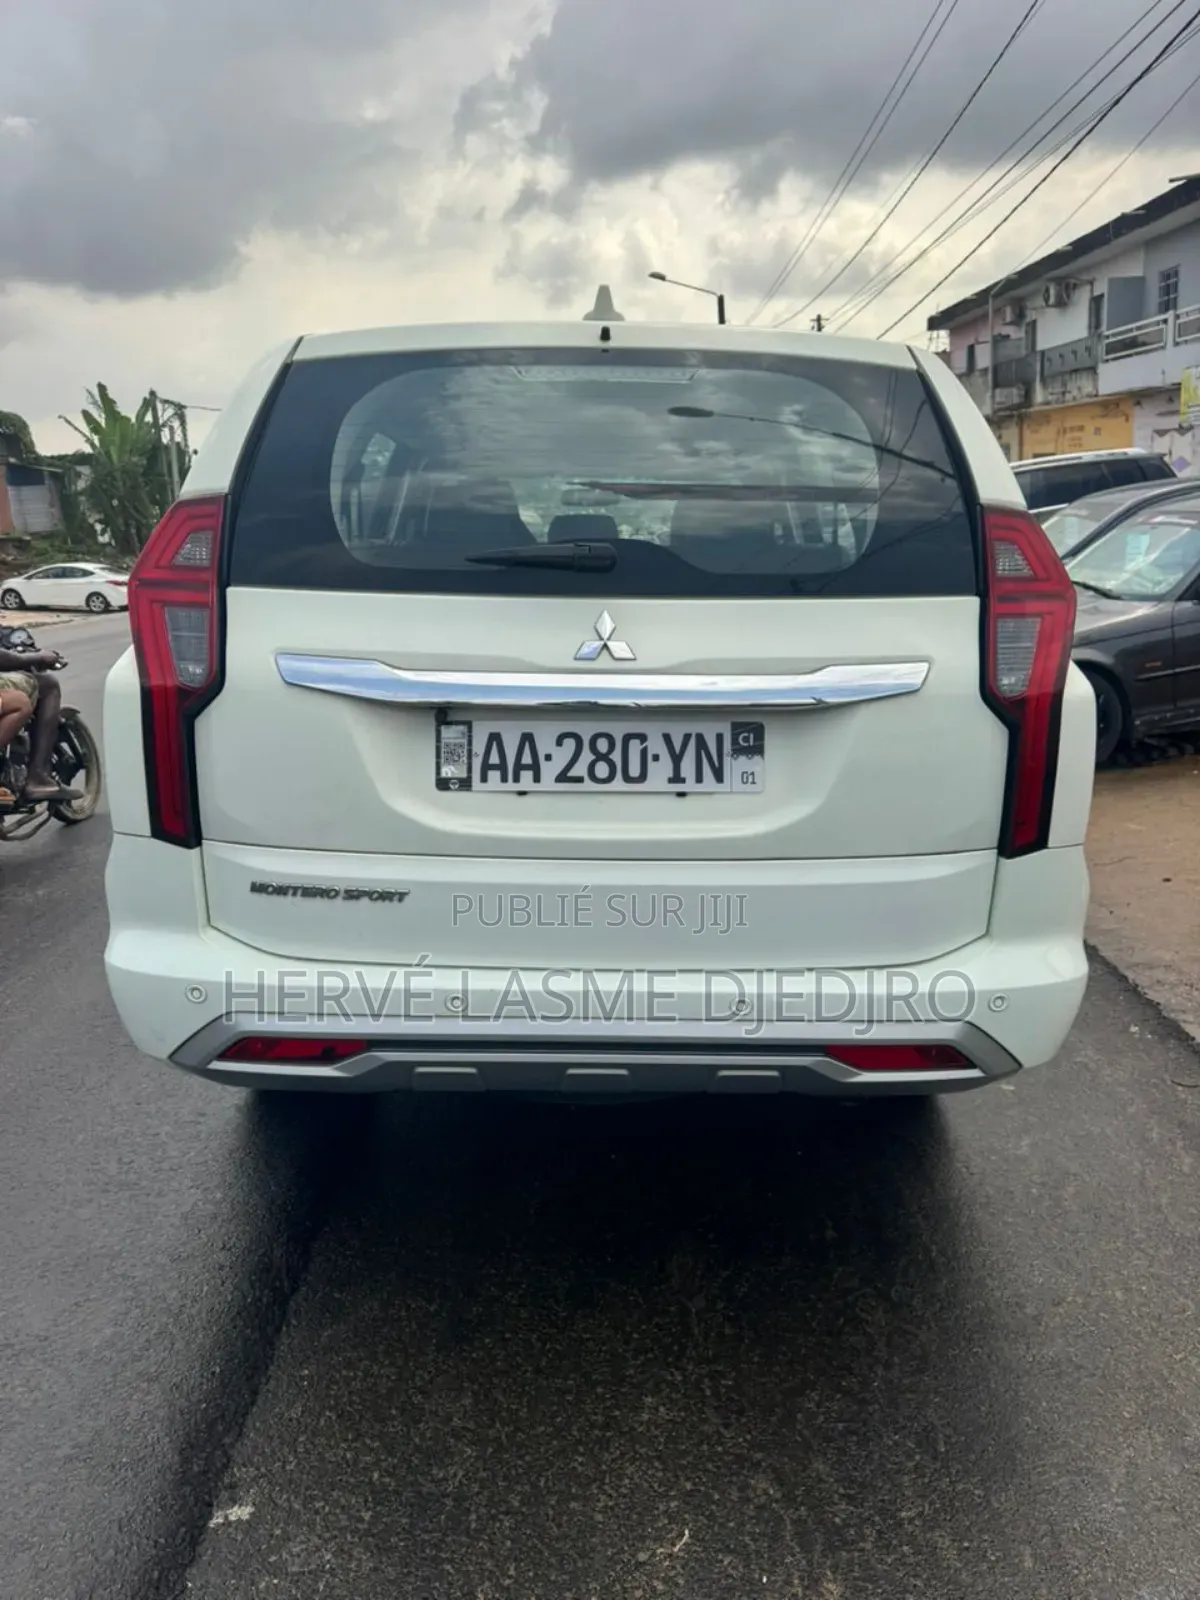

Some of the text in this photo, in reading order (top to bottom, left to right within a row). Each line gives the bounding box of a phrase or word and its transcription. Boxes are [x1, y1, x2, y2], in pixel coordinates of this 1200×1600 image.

[739, 733, 754, 746] CI
[741, 771, 757, 785] 01
[250, 881, 410, 902] MONTERO SPORT
